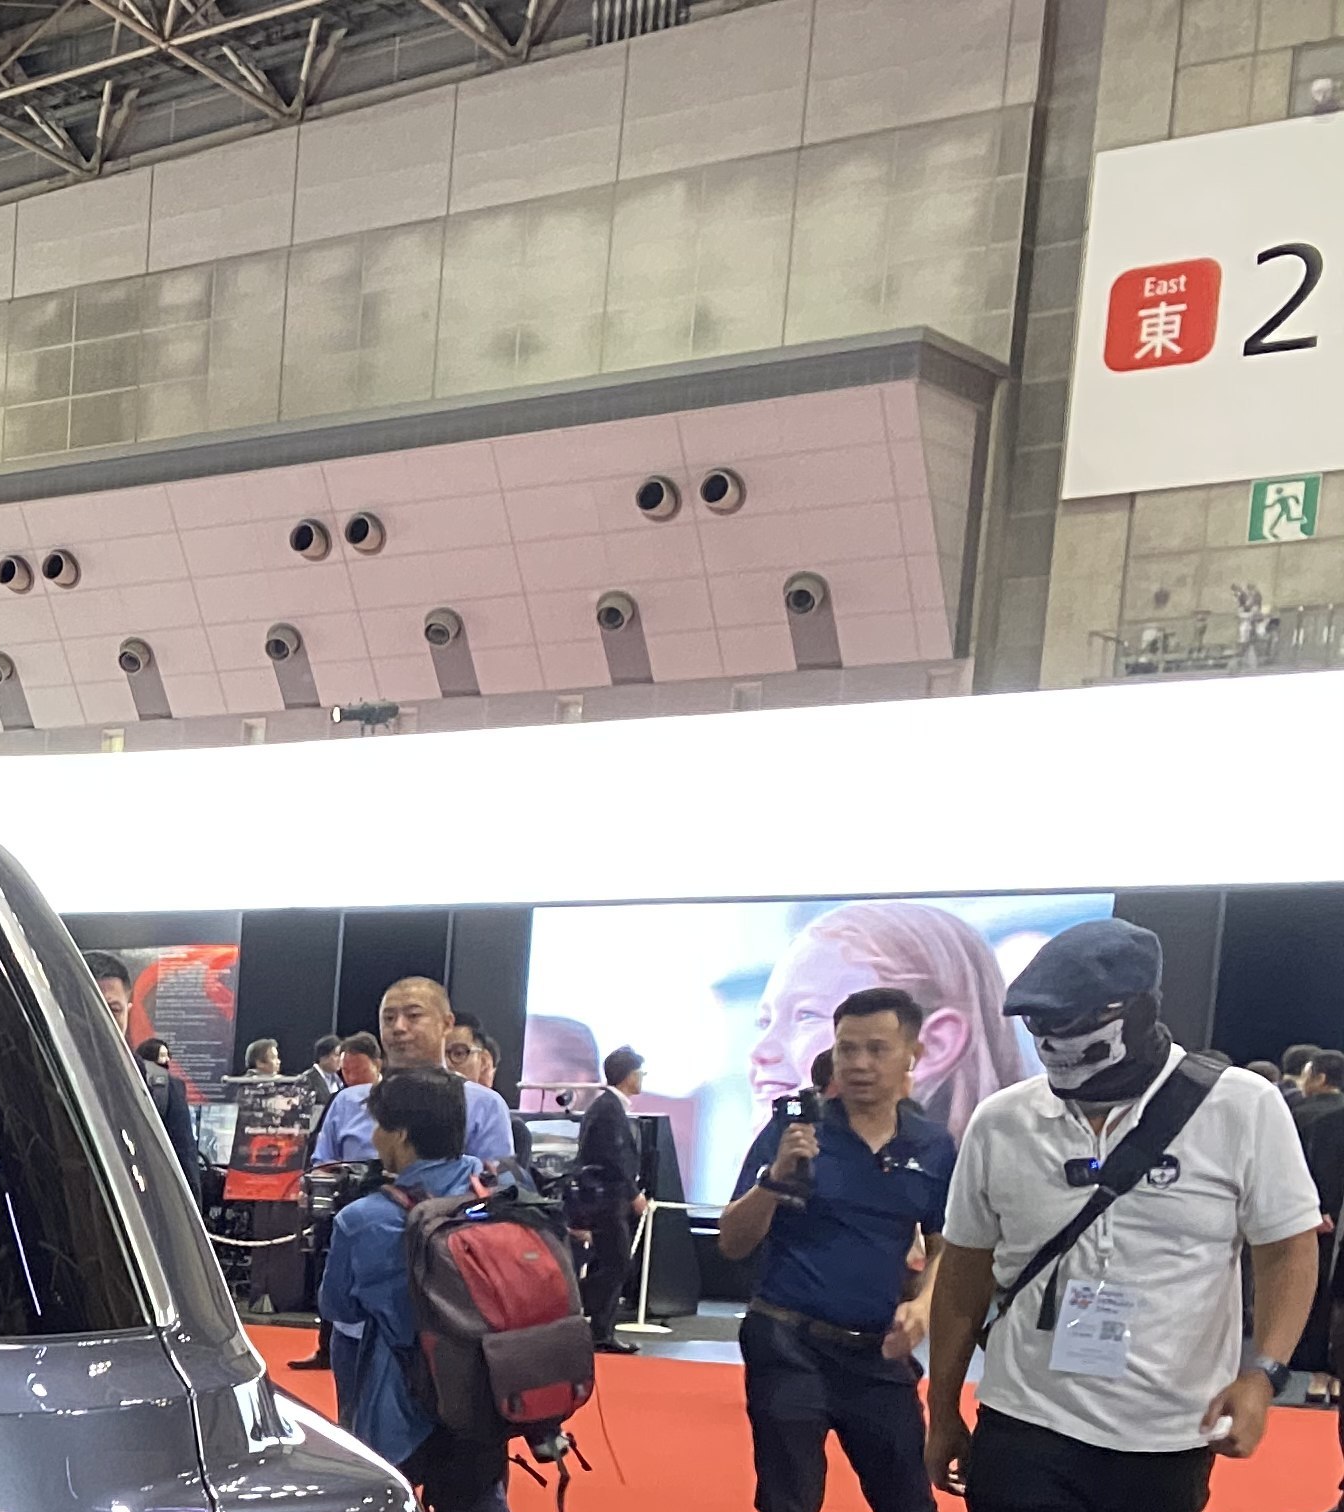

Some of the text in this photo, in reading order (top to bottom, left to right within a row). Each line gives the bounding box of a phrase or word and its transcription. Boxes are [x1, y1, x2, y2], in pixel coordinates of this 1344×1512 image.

[1143, 273, 1188, 298] East
[1242, 242, 1324, 358] 2
[1134, 301, 1188, 360] 東
